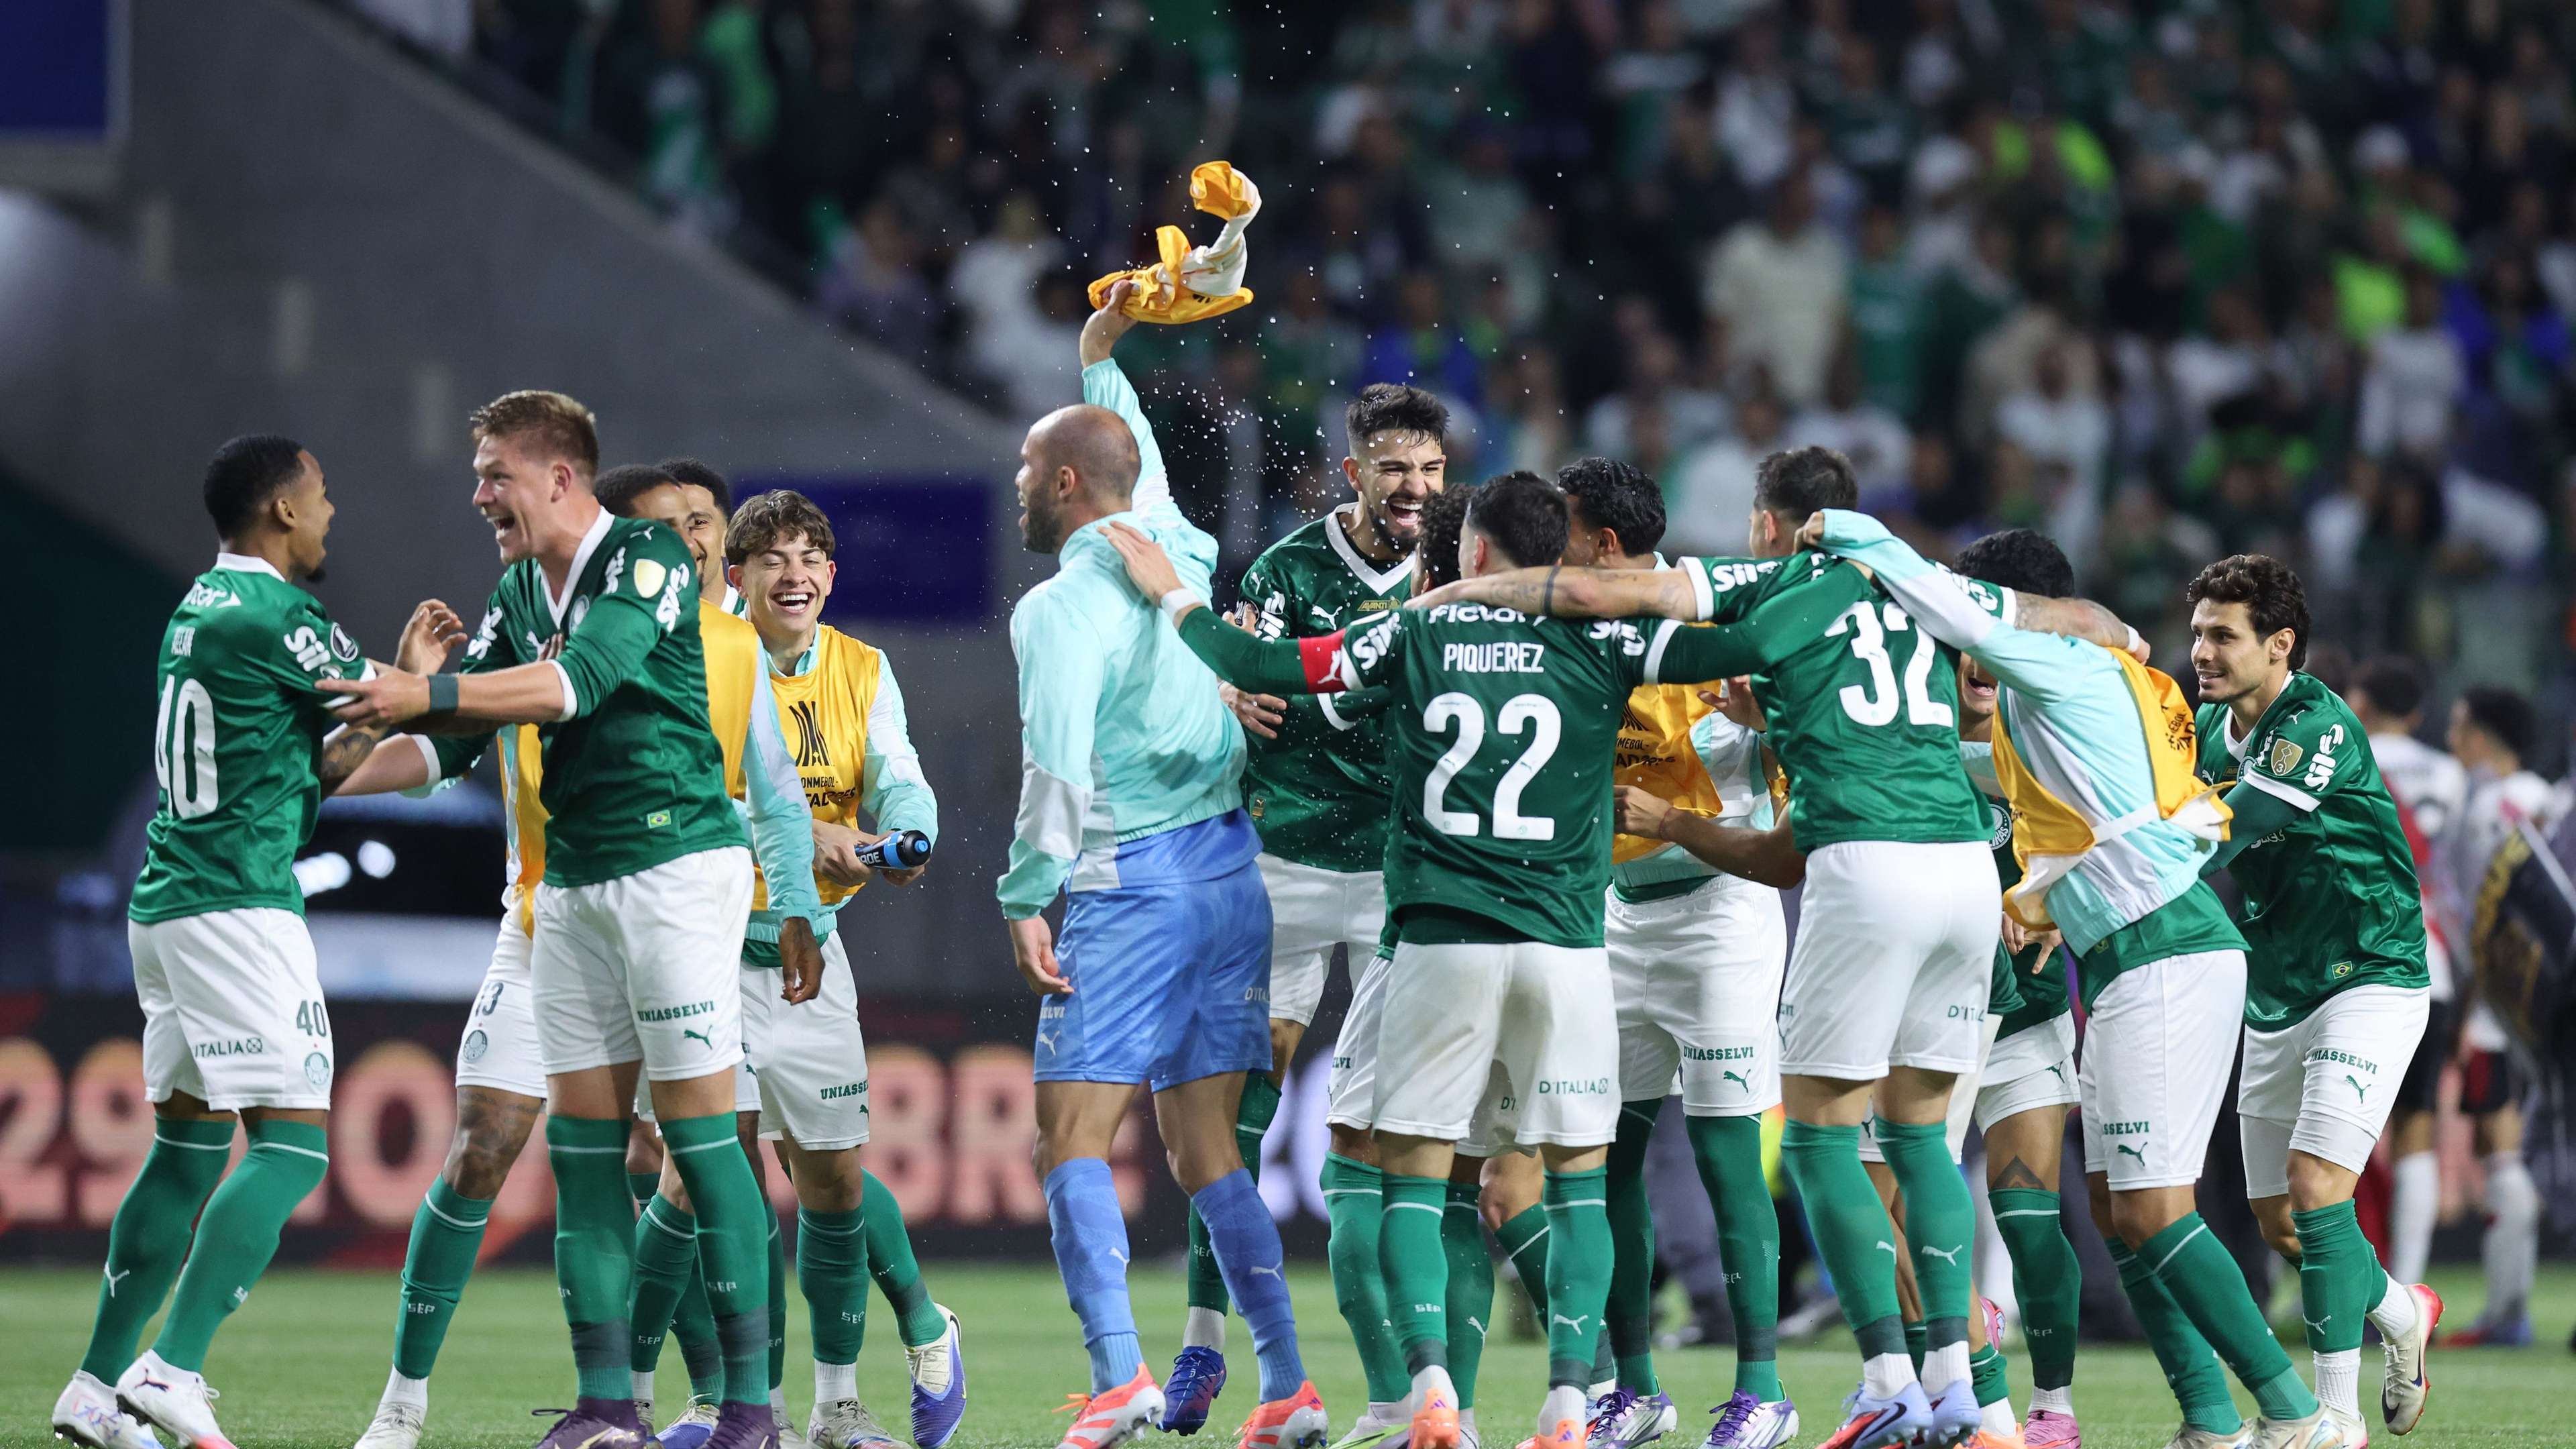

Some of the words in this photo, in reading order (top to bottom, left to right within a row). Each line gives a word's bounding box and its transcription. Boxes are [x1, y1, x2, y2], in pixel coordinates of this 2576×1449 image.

[1444, 642, 1545, 674] PIQUEREZ
[1824, 600, 1953, 727] 32
[154, 674, 219, 820] 40
[1423, 692, 1562, 841] 22
[2275, 763, 2284, 773] 3
[800, 775, 835, 789] ONMEBOL
[296, 1000, 327, 1037] 40
[637, 1000, 714, 1022] UNIASSELVI
[195, 1040, 244, 1058] ITALIA
[1683, 1046, 1754, 1061] UNIASSELVI
[820, 1079, 869, 1100] UNIASSE
[2104, 1121, 2149, 1135] SSELVI
[408, 1303, 435, 1314] SEP
